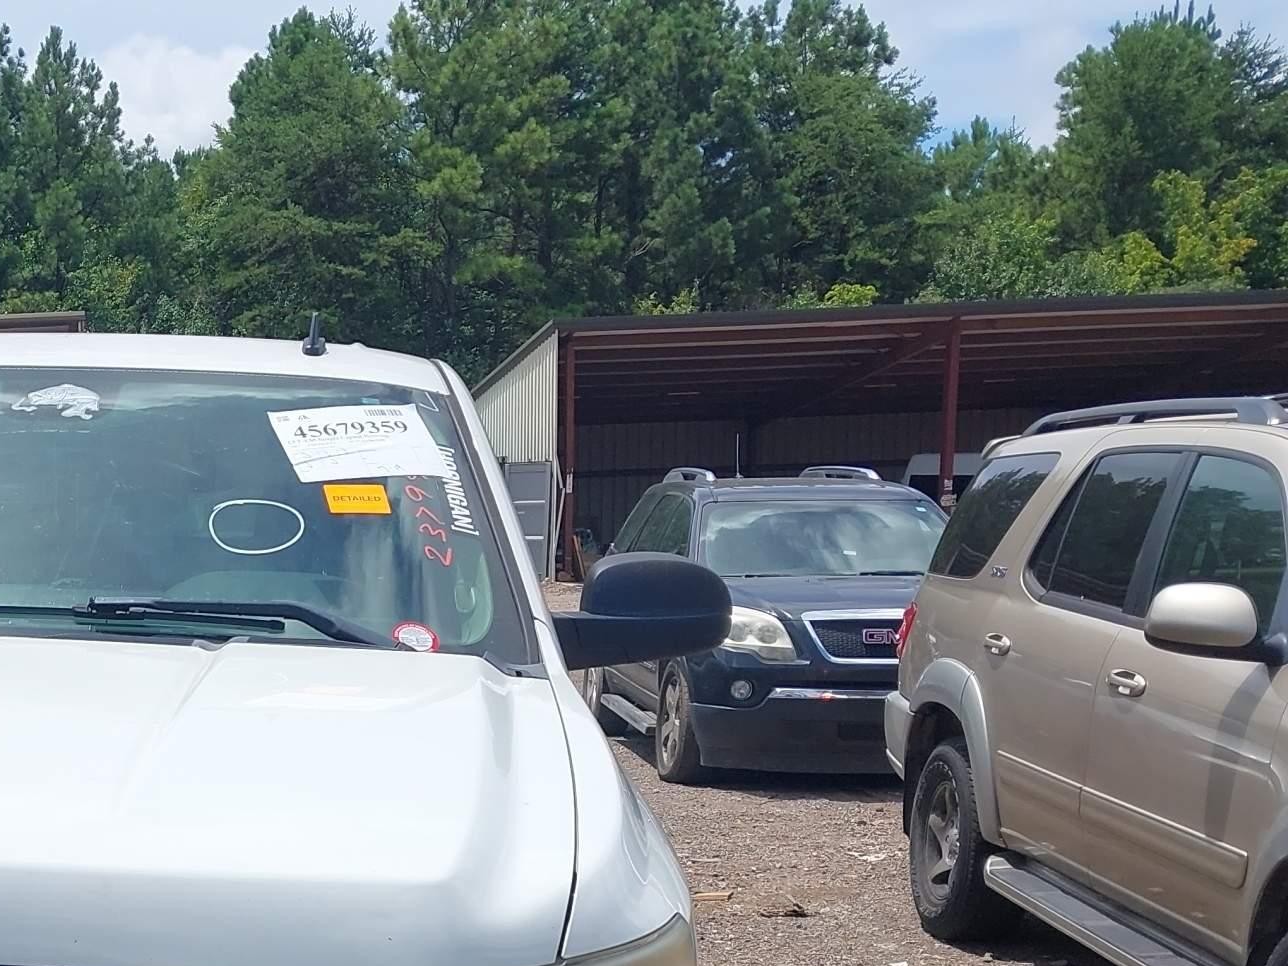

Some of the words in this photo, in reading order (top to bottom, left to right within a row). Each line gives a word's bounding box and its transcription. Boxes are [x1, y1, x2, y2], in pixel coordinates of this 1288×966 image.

[293, 420, 408, 439] 45679359
[404, 485, 452, 567] 2379
[862, 629, 900, 644] GM
